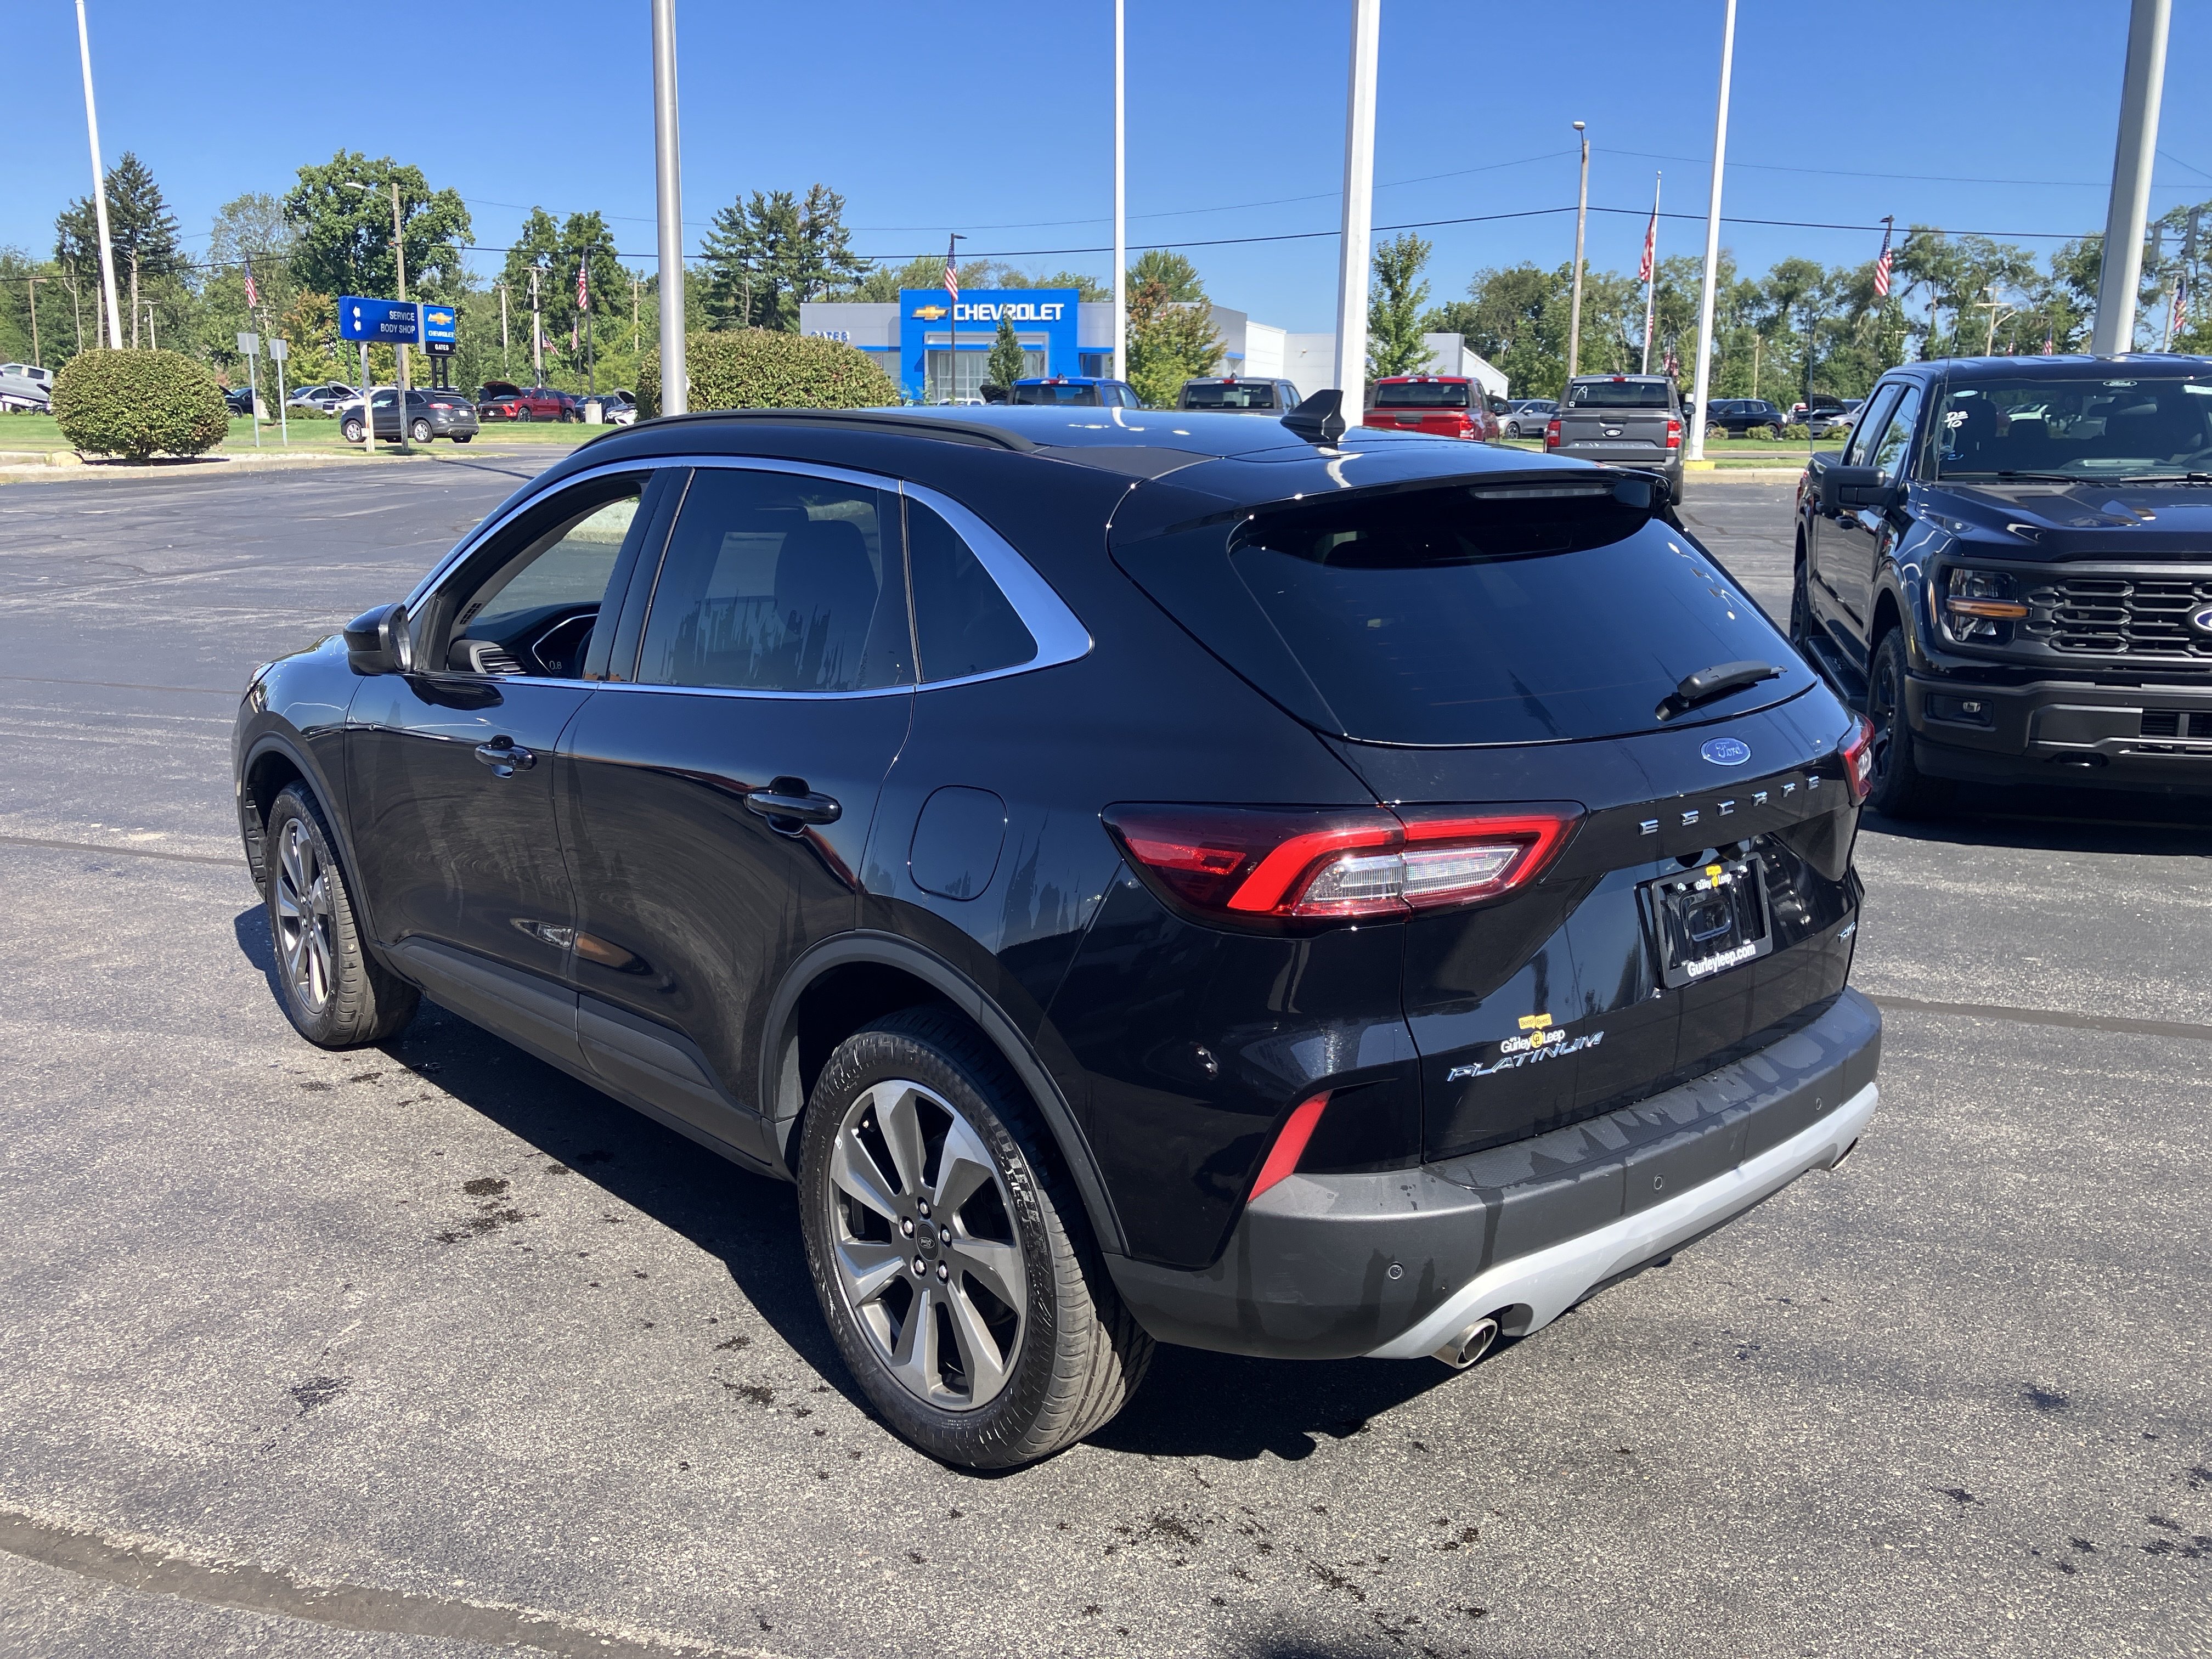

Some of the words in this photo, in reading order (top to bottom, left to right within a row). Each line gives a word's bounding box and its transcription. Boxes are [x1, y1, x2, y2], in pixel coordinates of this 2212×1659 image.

[389, 310, 415, 321] SERVICE
[953, 303, 1064, 321] CHEVROLET
[380, 323, 397, 333] BODY
[399, 324, 415, 334] SHOP
[549, 661, 562, 670] 0.8
[1716, 741, 1743, 758] Ford
[1639, 775, 1819, 836] ESCAPE
[1718, 873, 1731, 884] Leep
[1687, 944, 1756, 977] Gurleyleep.com
[1500, 1036, 1532, 1053] Gurley
[1543, 1029, 1565, 1044] Leep
[1446, 1031, 1605, 1082] PLATINUM
